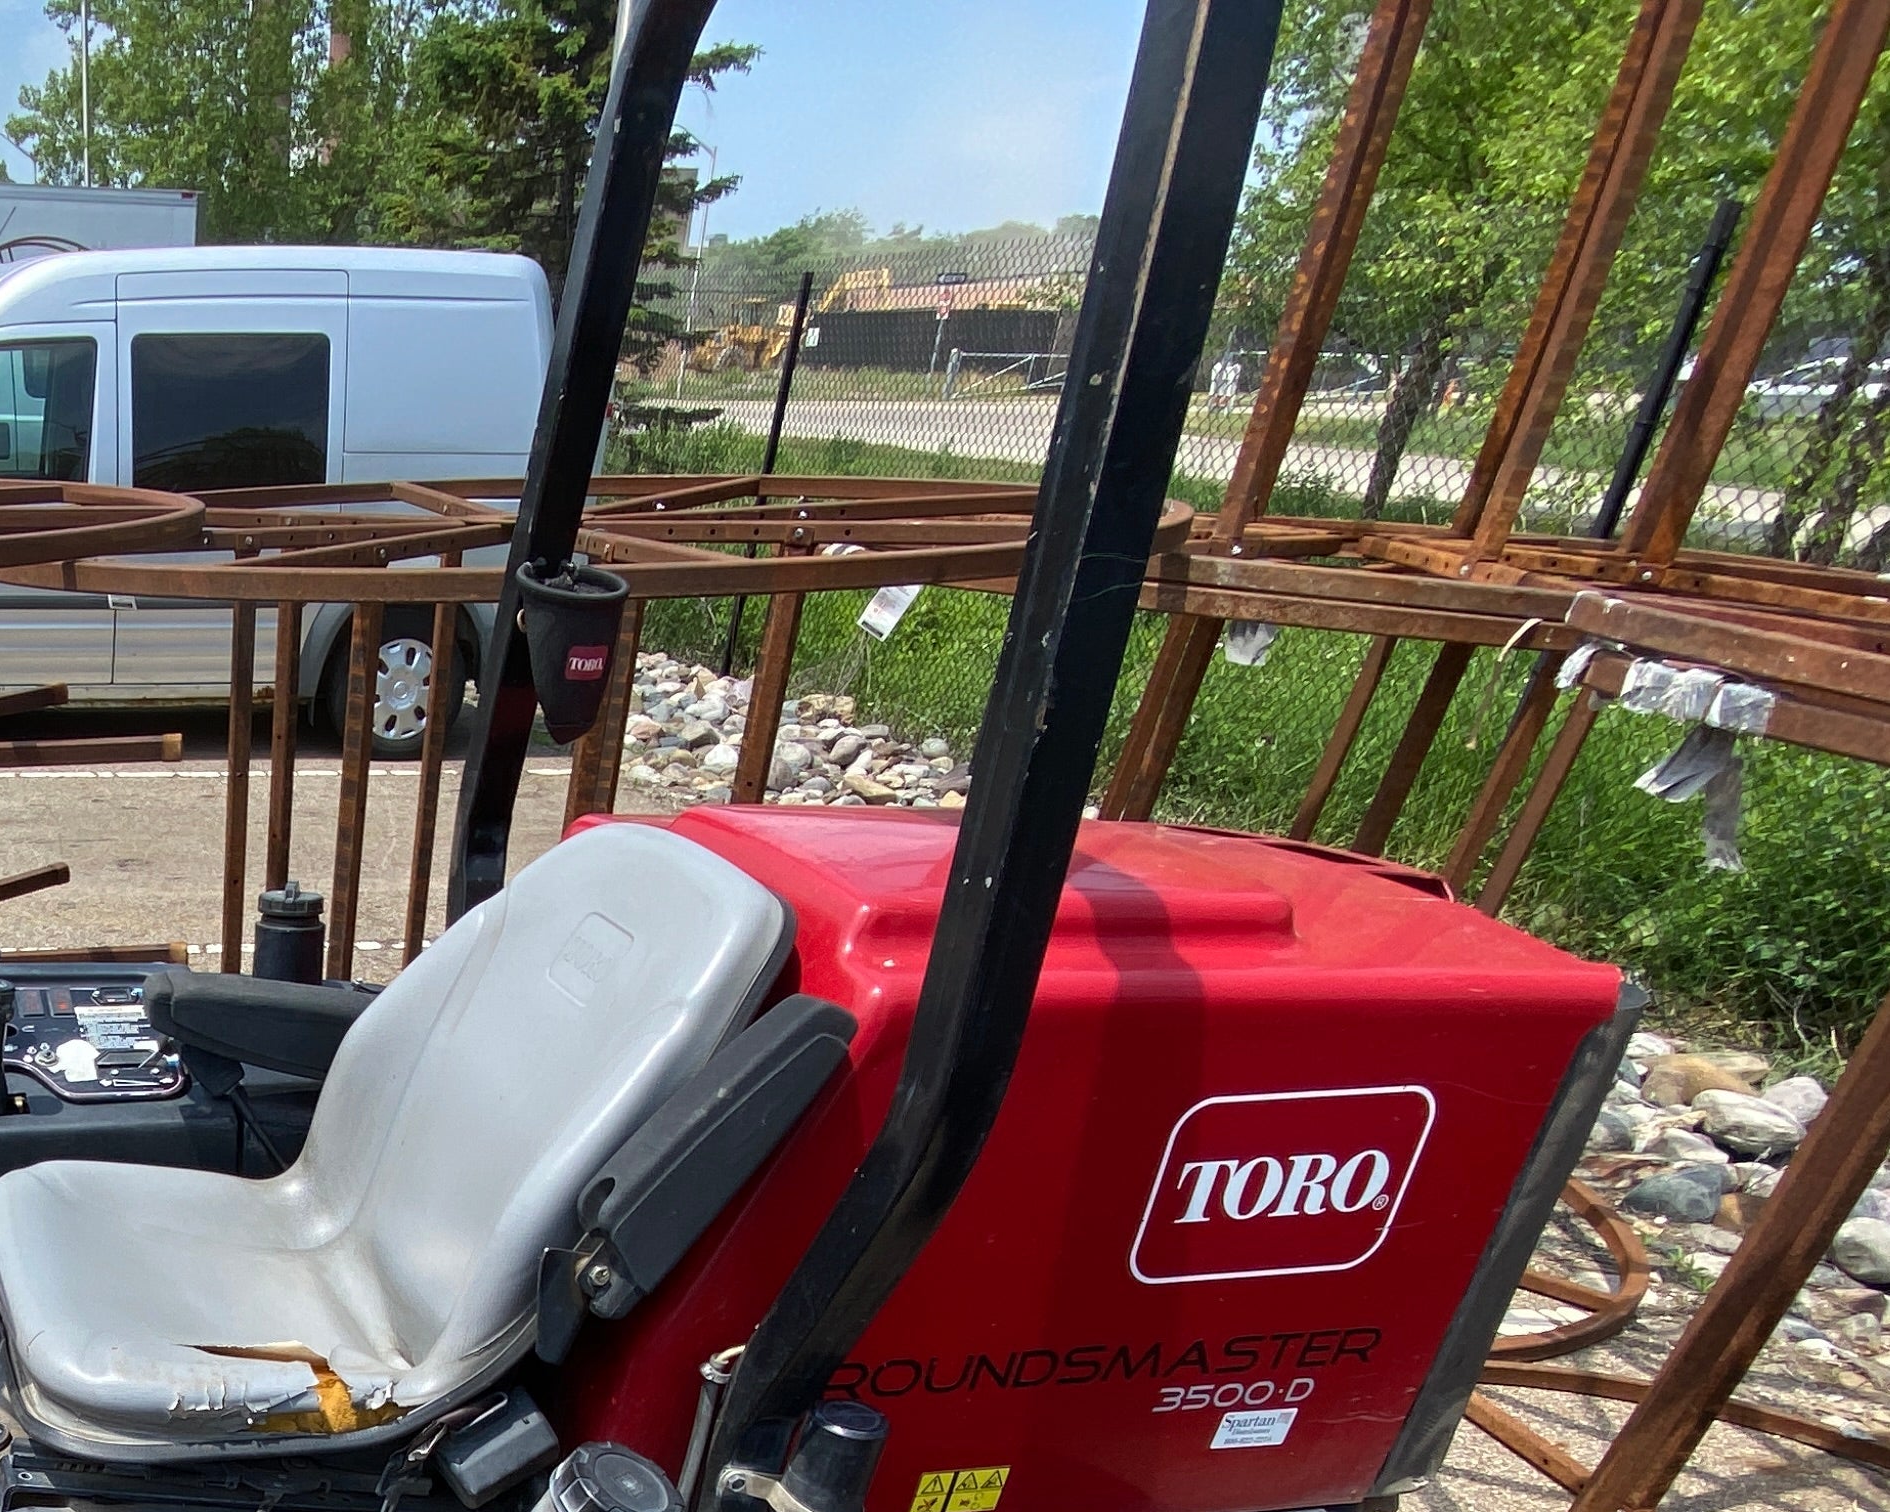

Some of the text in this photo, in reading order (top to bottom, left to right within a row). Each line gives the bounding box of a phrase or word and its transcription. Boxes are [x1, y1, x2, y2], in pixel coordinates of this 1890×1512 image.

[569, 656, 604, 671] TORO
[1172, 1149, 1389, 1225] TORO
[822, 1327, 1382, 1400] ROUNDSMASTER
[1222, 1415, 1277, 1432] Spartan
